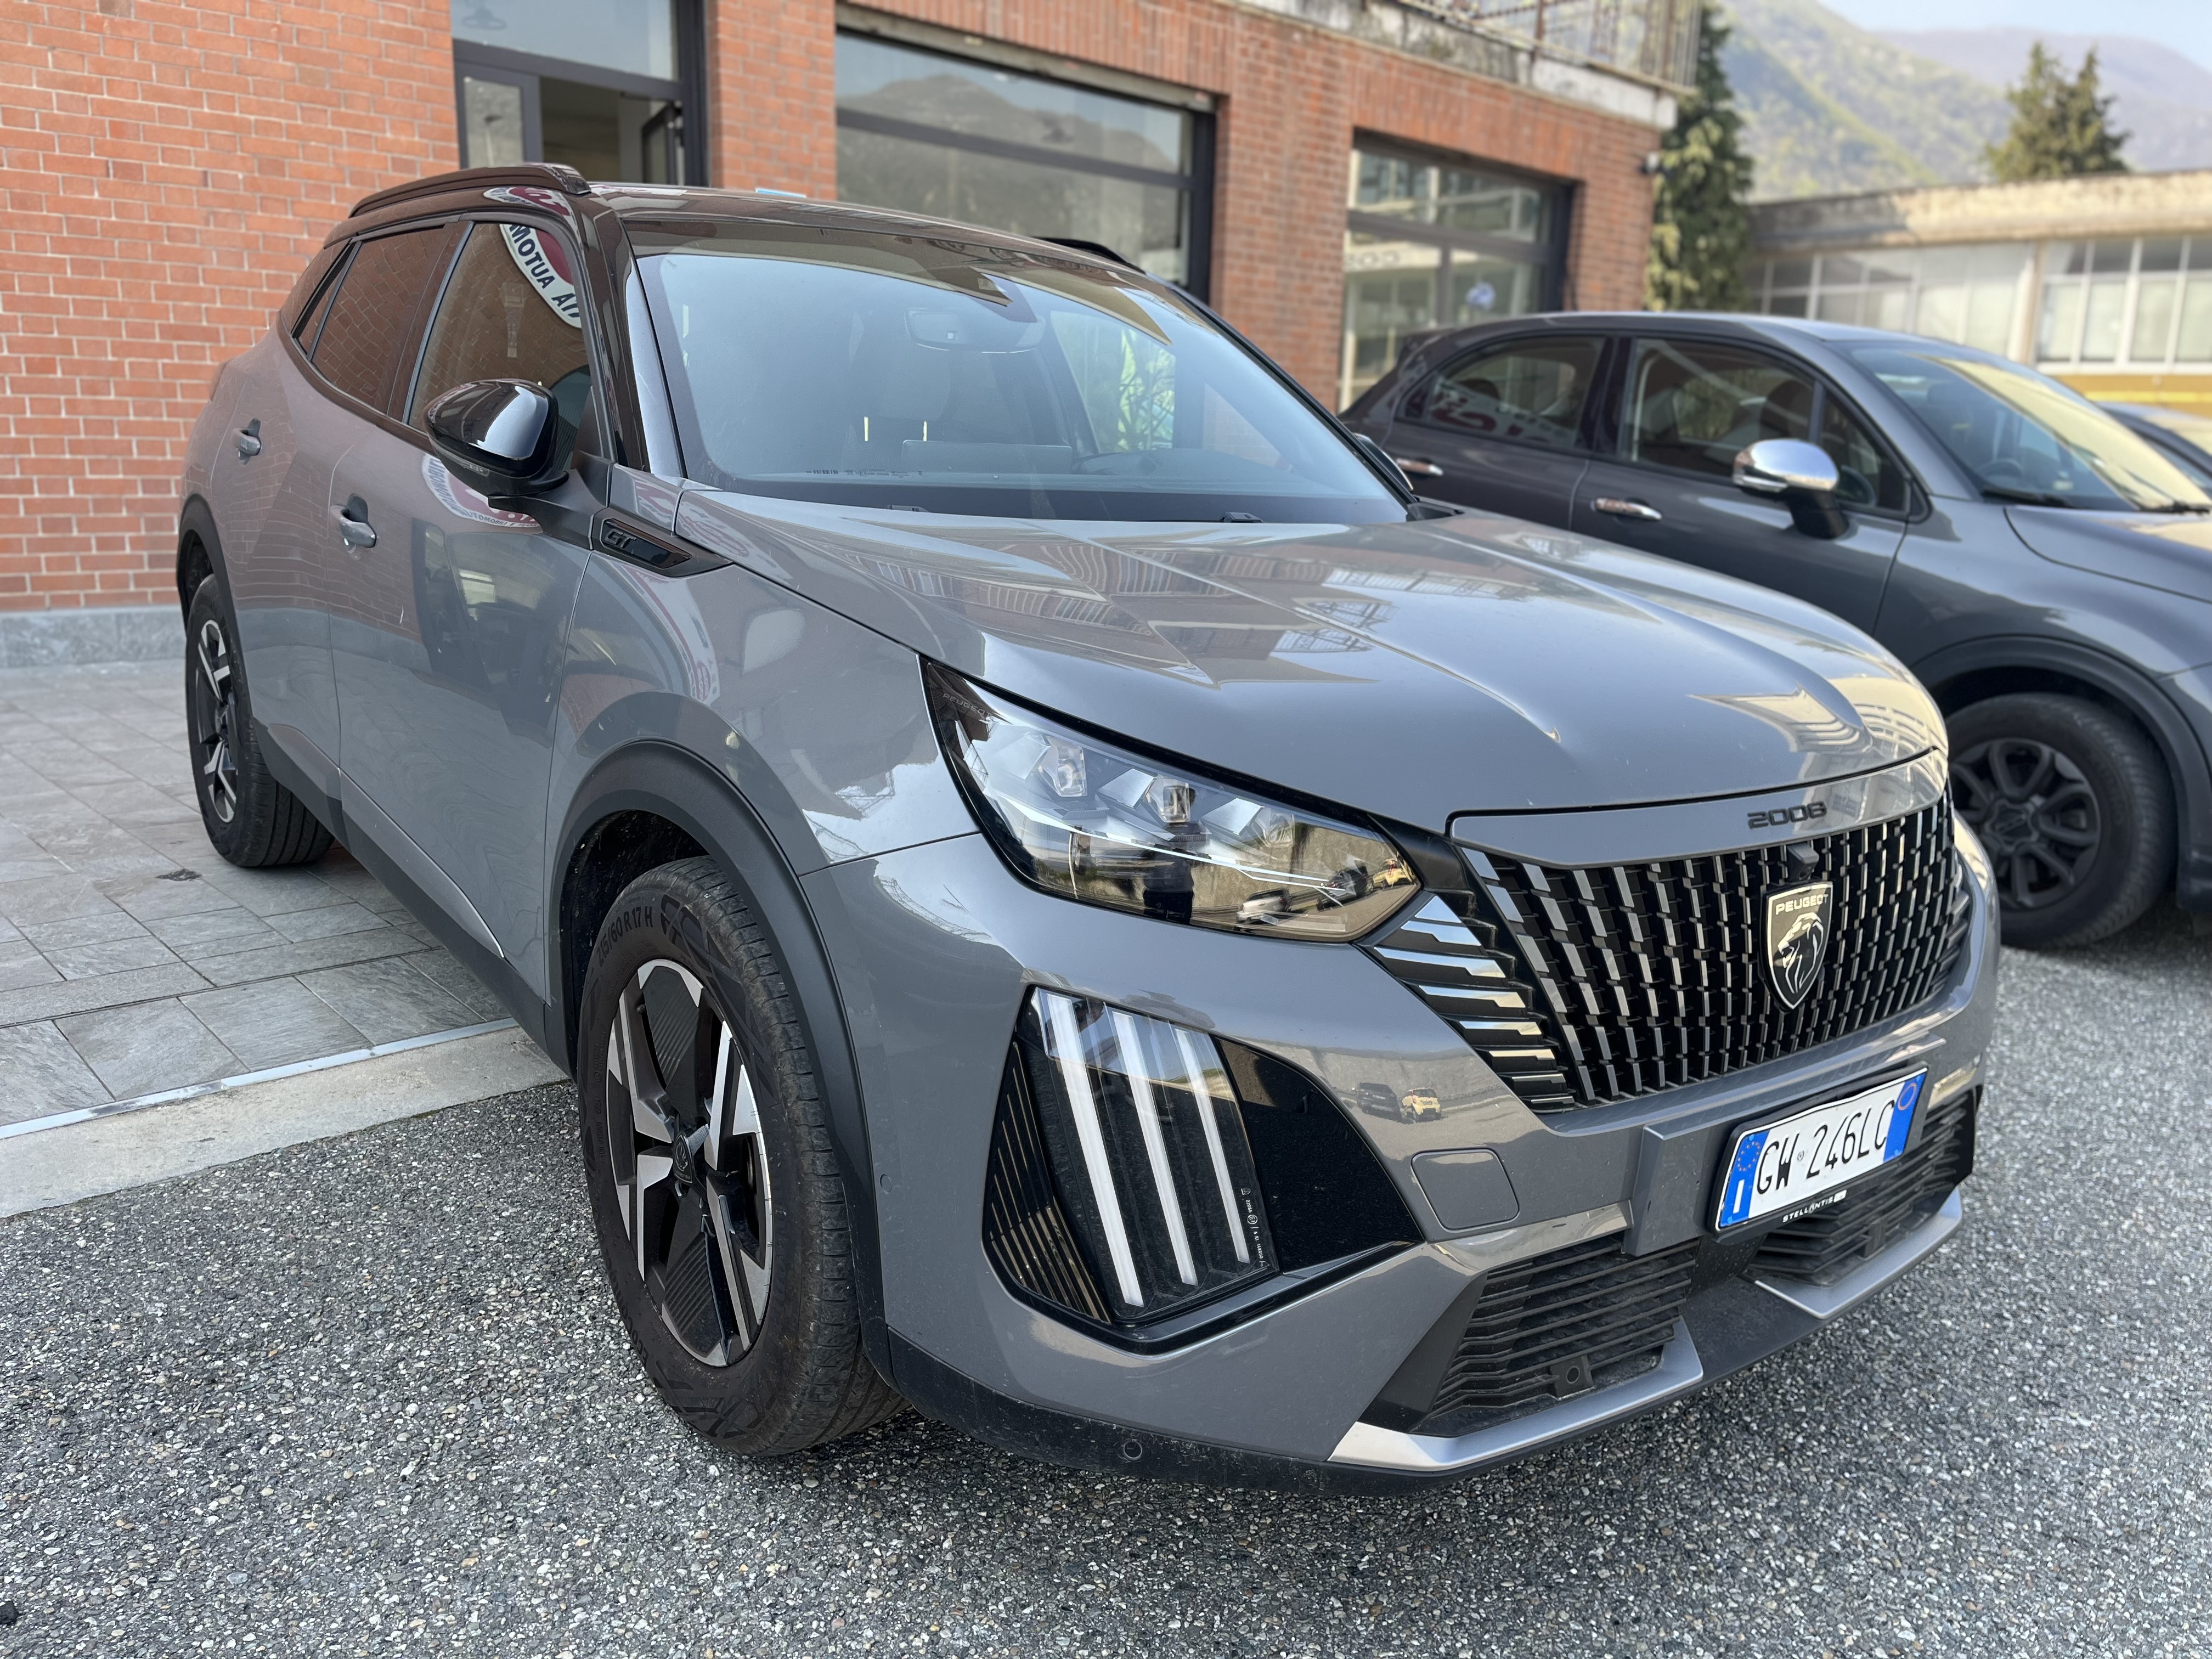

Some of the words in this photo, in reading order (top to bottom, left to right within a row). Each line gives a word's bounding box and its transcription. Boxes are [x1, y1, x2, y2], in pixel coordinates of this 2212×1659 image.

[604, 528, 636, 548] GT
[943, 693, 992, 717] PEUGEOT
[1747, 800, 1827, 830] 2008
[1775, 894, 1829, 915] PEUGEOT
[596, 916, 623, 967] 215/60
[624, 911, 632, 932] R
[631, 906, 641, 928] 17
[645, 906, 653, 928] H
[1756, 1132, 1800, 1195] GW
[1805, 1099, 1895, 1180] 246LC
[1733, 1179, 1745, 1214] I
[1782, 1195, 1833, 1223] STELLANTIS
